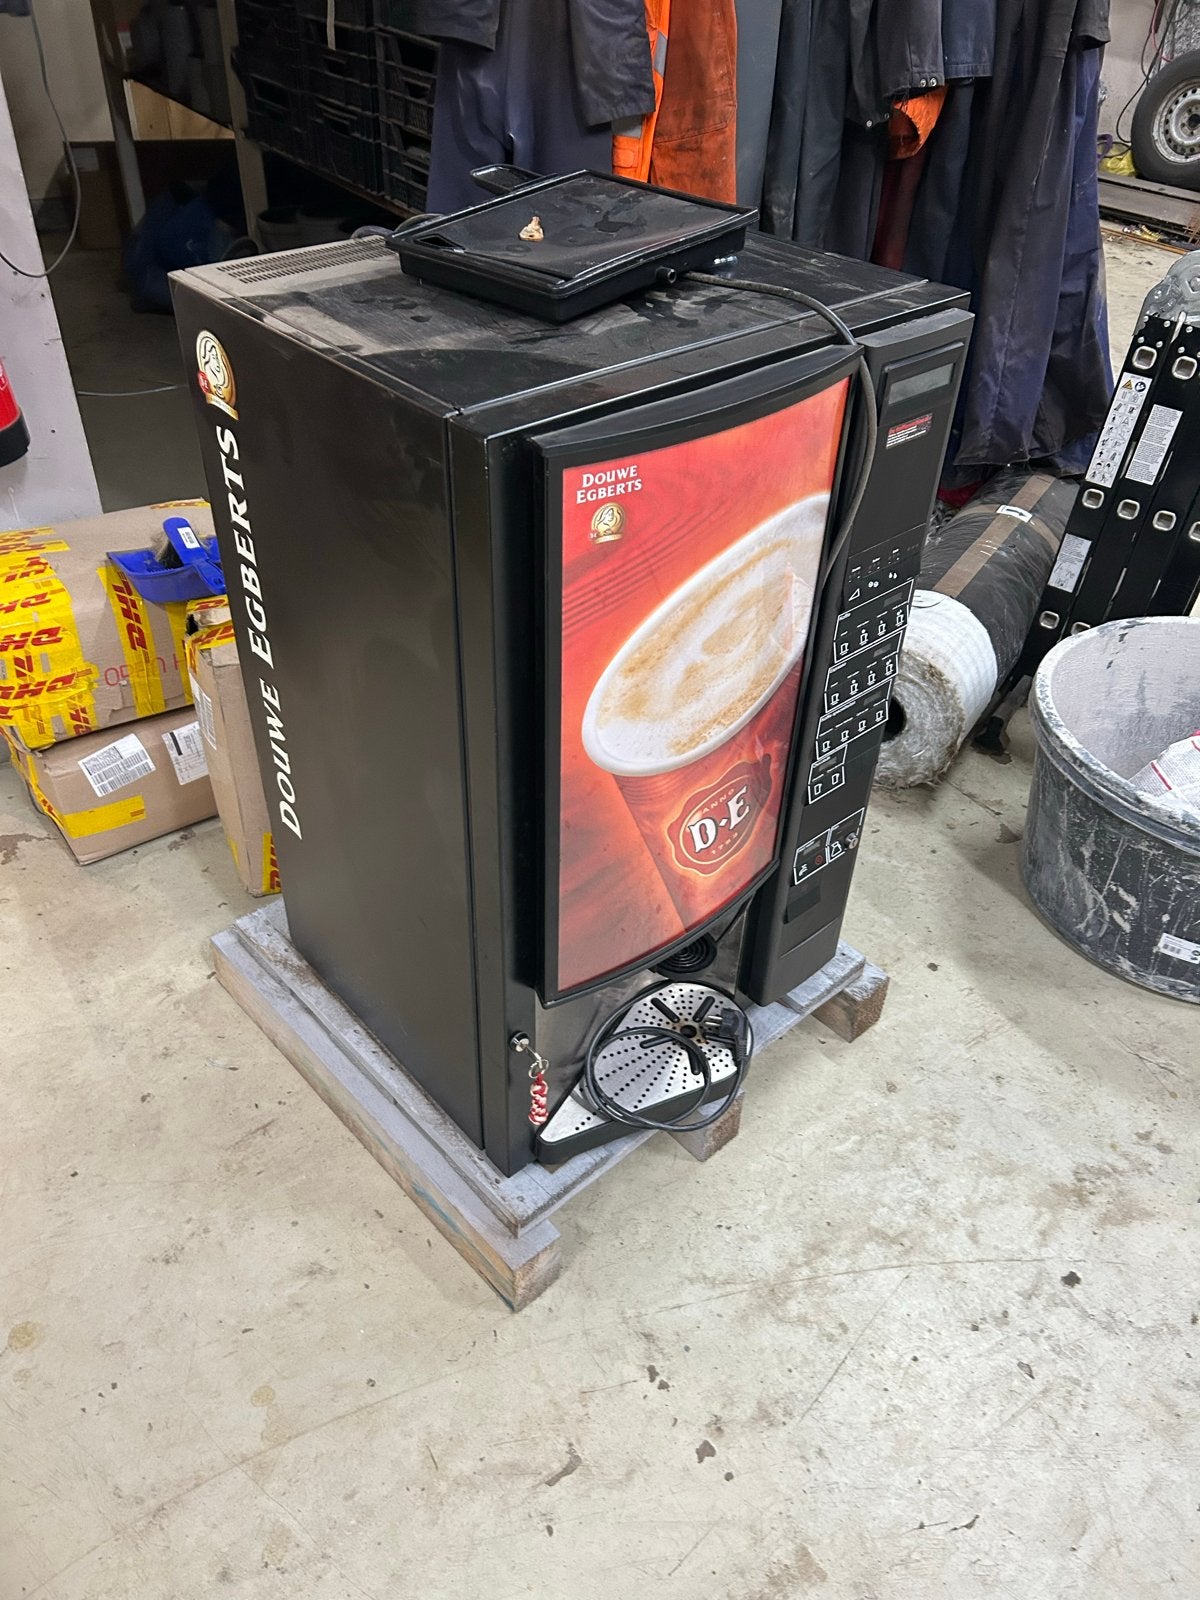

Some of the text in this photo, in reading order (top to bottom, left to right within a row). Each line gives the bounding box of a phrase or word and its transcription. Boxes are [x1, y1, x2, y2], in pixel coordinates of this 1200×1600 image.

[576, 479, 643, 504] EGBERTS
[582, 465, 638, 488] DOUWE
[216, 423, 275, 671] EGBERTS
[112, 579, 149, 651] DHL
[257, 677, 303, 841] DOUWE
